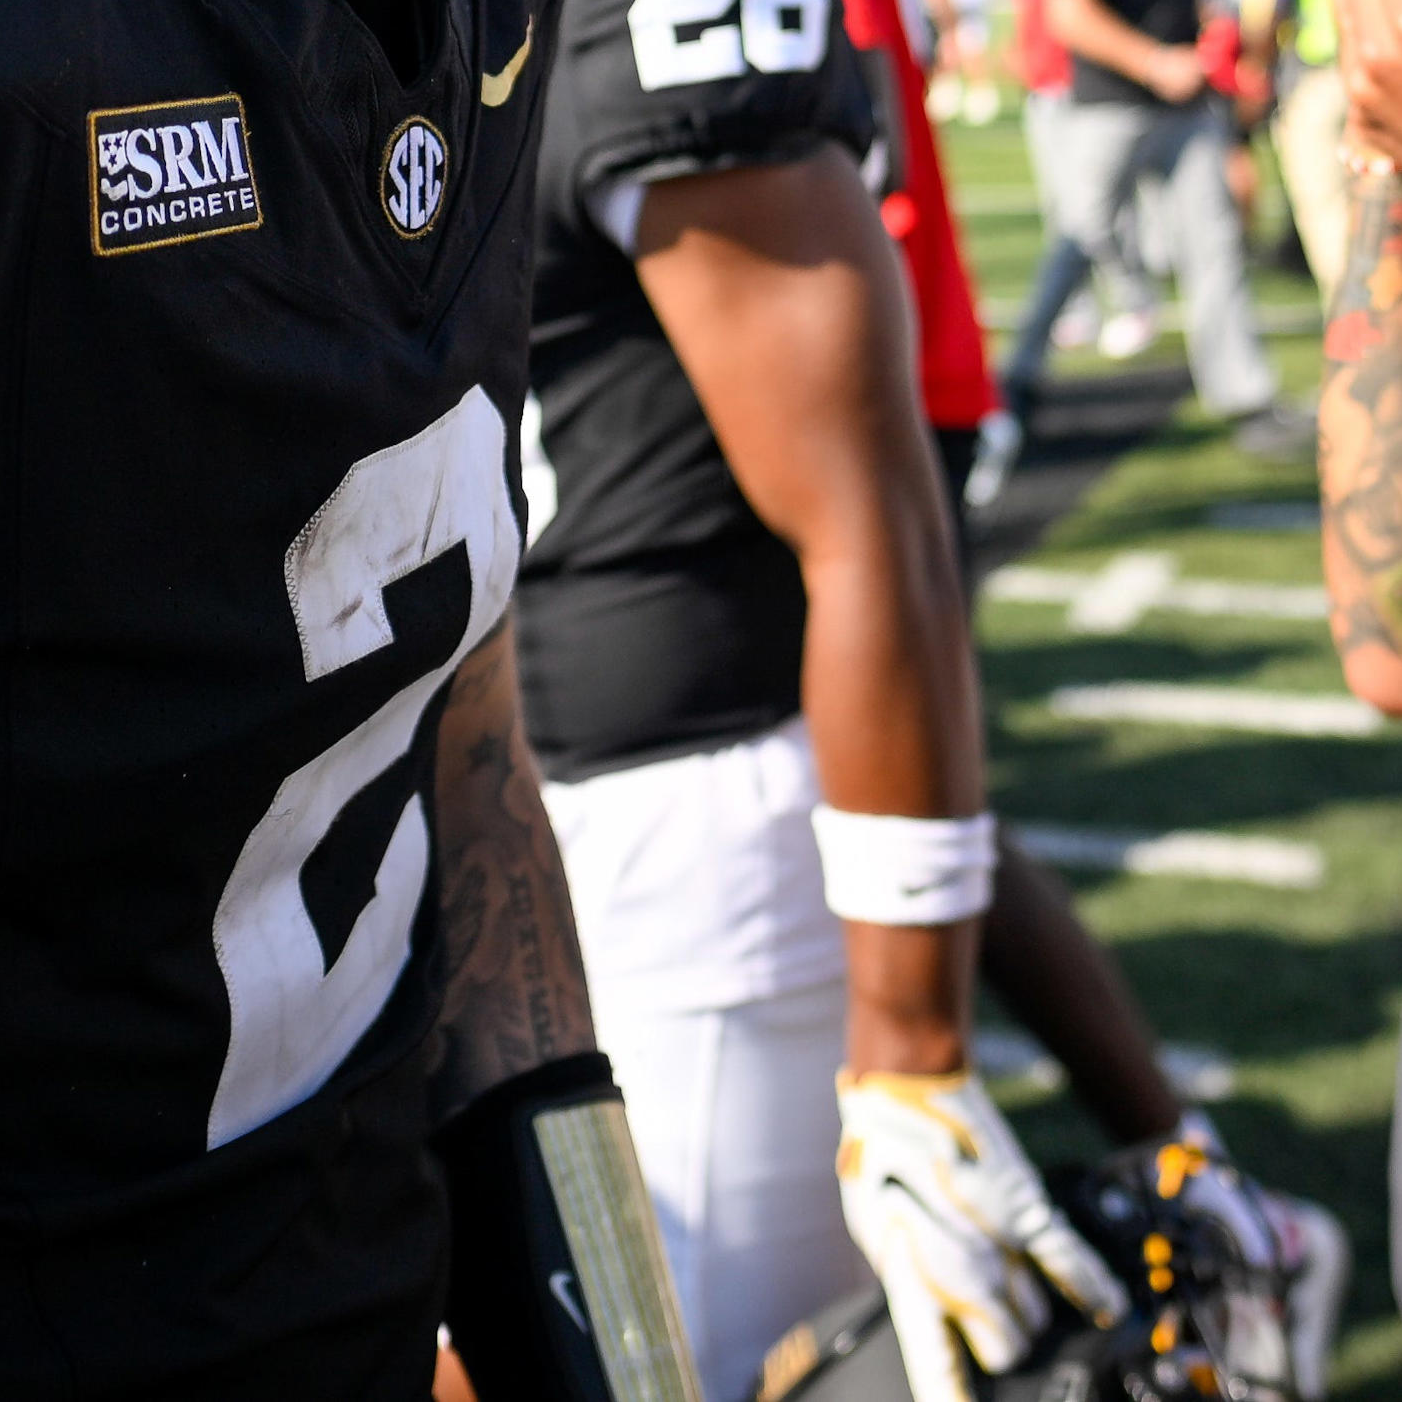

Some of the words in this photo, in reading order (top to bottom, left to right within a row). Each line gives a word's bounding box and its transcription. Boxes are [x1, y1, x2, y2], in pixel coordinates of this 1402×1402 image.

[125, 116, 250, 202] SRM
[385, 125, 446, 232] SEC
[100, 187, 255, 236] CONCRETE
[206, 383, 521, 1152] 2
